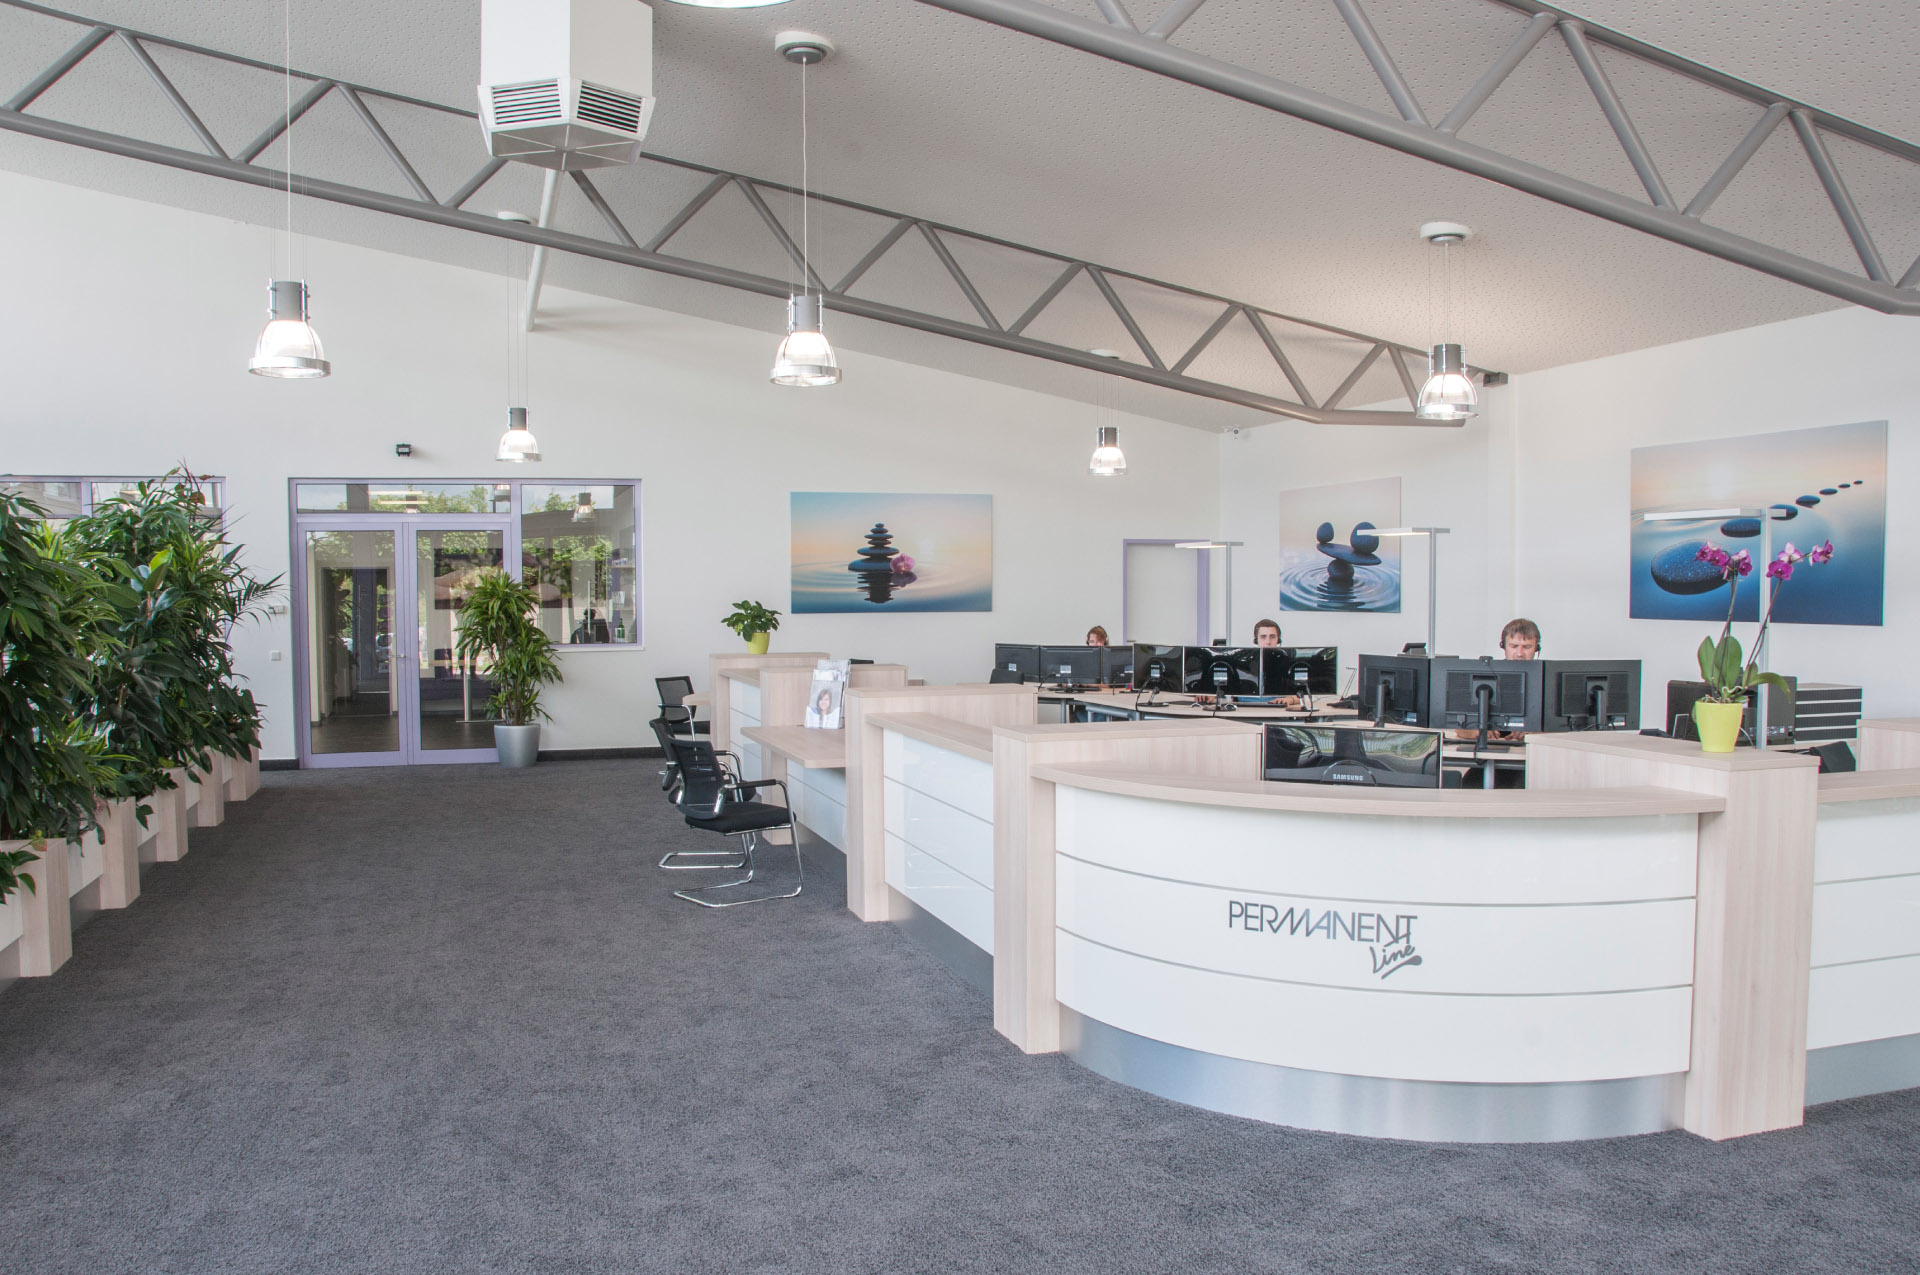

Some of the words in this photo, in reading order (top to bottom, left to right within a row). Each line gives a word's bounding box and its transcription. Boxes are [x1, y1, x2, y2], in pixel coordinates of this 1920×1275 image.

[1332, 773, 1364, 781] SAMSUNG
[1228, 900, 1418, 945] PERMANENT
[1369, 943, 1417, 975] Line
